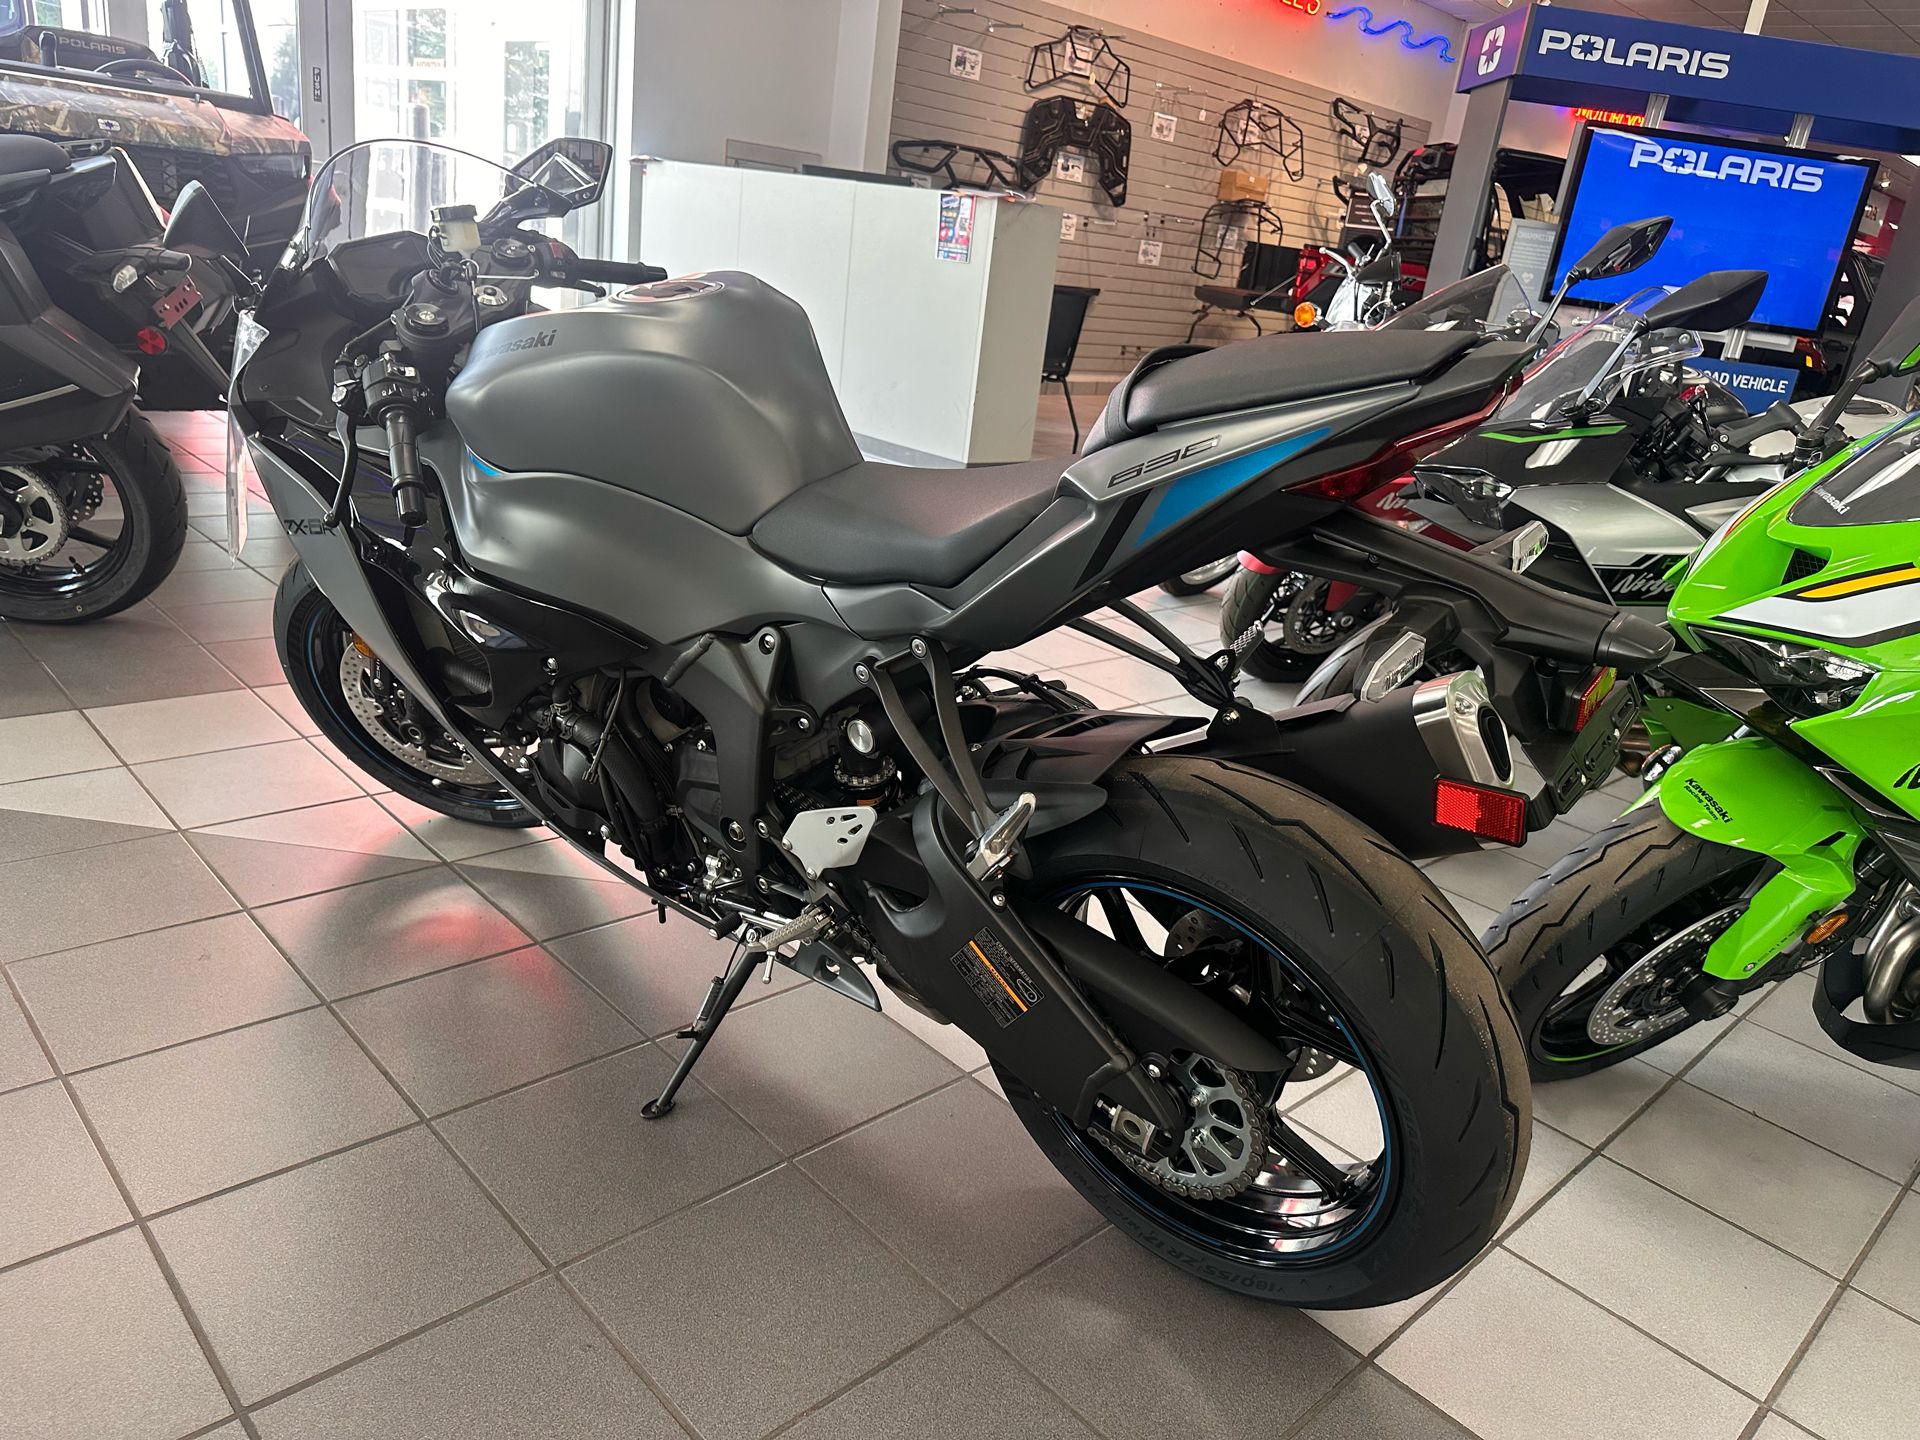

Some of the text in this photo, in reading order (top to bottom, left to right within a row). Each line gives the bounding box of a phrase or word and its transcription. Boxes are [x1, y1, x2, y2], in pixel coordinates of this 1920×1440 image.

[59, 36, 126, 55] POLARIS
[1538, 29, 1731, 79] POLARIS
[1629, 142, 1824, 193] POLARIS
[1733, 373, 1788, 393] VEHICLE
[1107, 434, 1222, 488] 636
[1685, 778, 1733, 823] Kawasaki
[1704, 803, 1718, 820] Team
